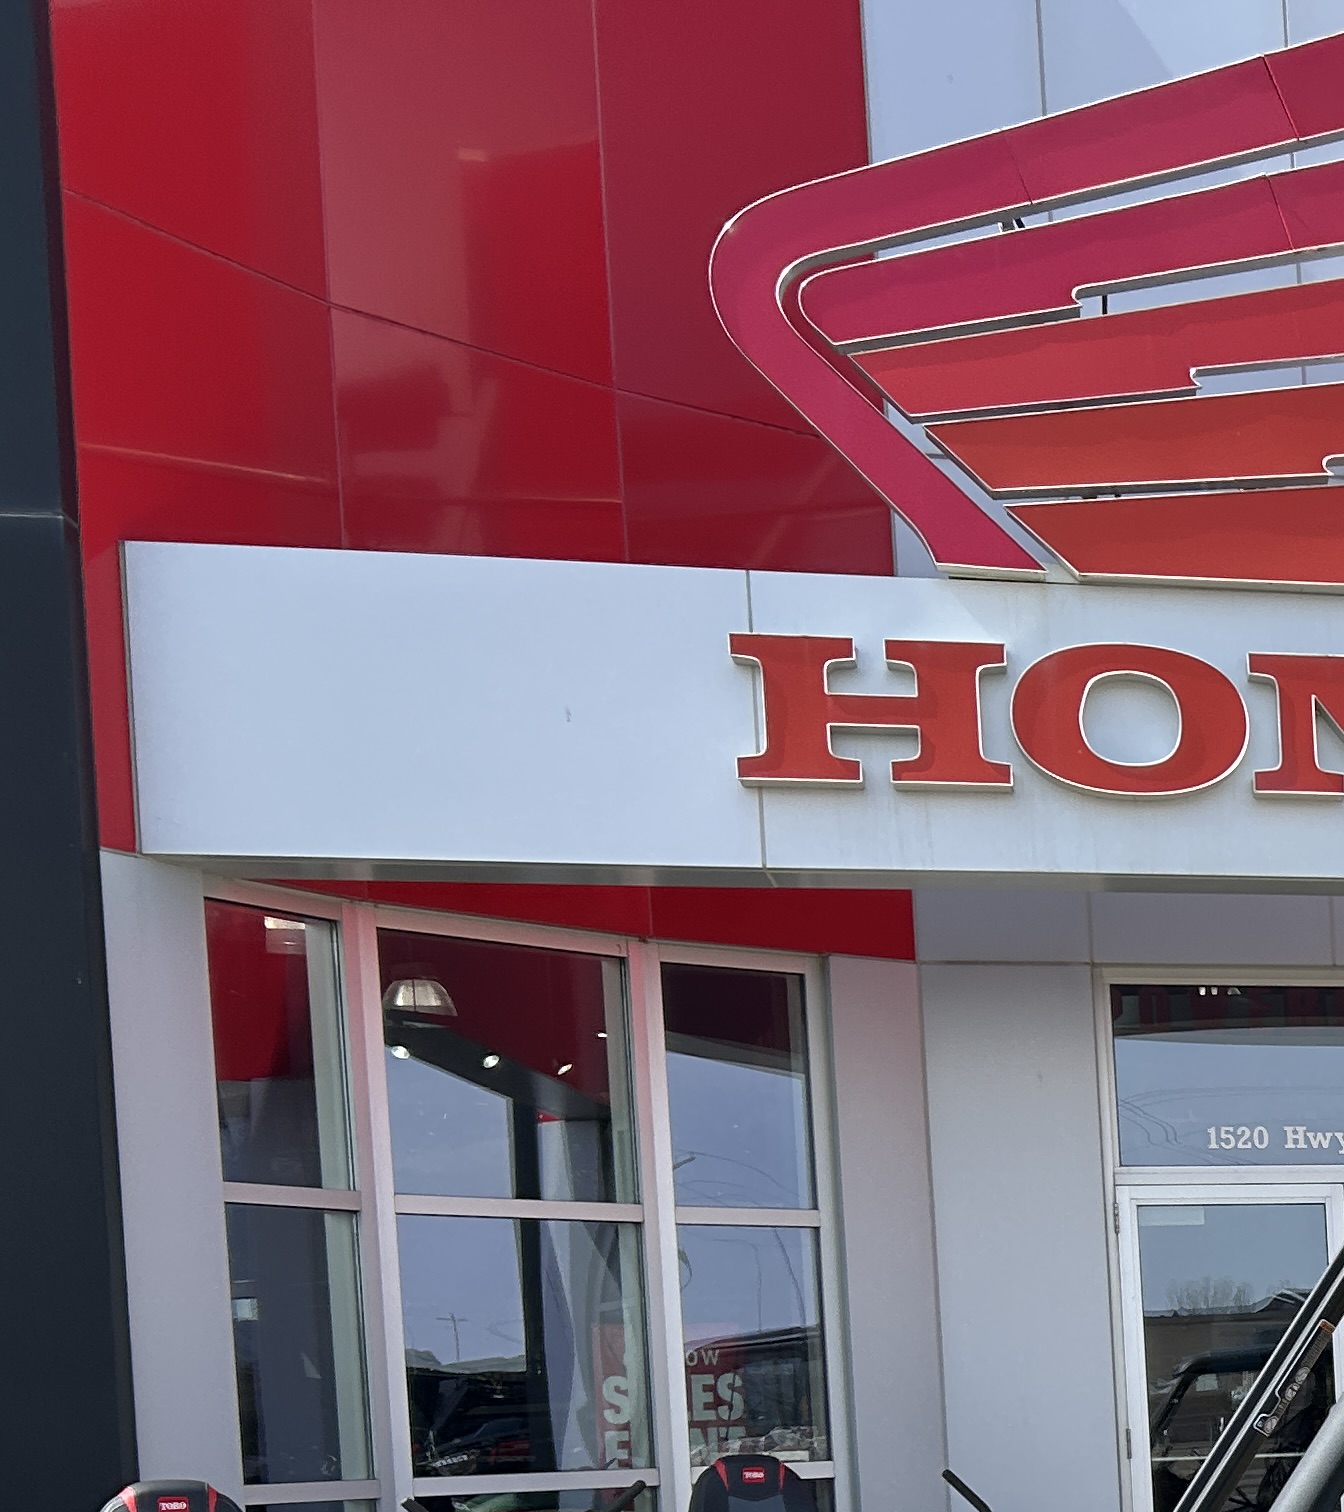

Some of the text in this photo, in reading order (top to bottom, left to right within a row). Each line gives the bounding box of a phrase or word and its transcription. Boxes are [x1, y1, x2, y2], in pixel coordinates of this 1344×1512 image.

[1207, 1126, 1269, 1150] 1520
[686, 1349, 720, 1367] OW
[602, 1372, 745, 1425] SES
[159, 1502, 187, 1511] TORO
